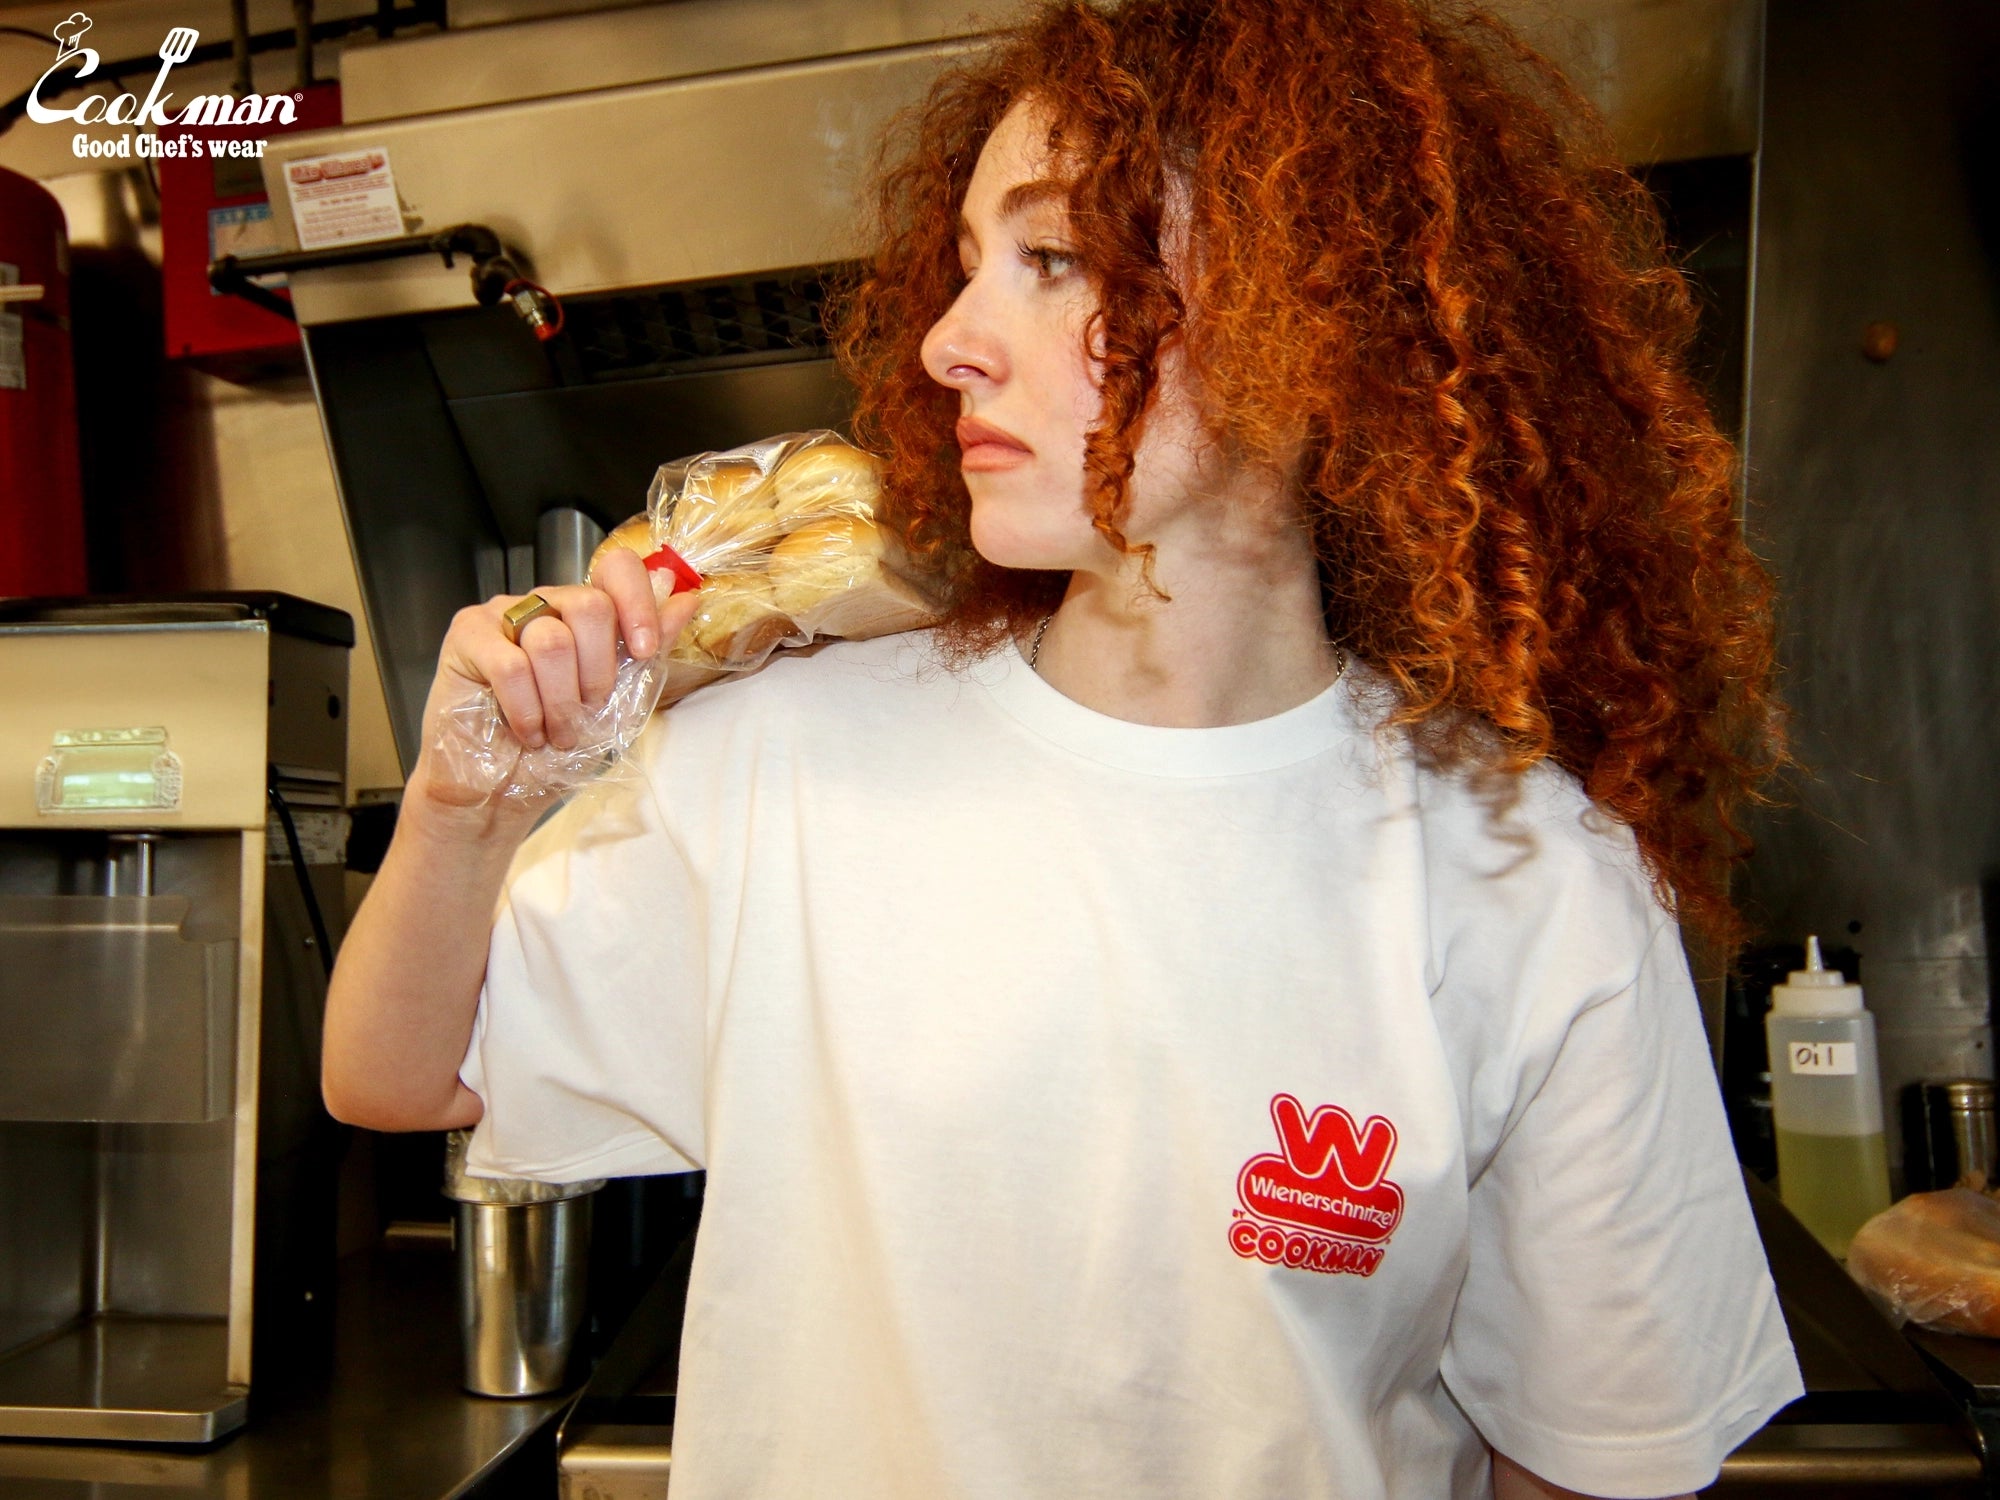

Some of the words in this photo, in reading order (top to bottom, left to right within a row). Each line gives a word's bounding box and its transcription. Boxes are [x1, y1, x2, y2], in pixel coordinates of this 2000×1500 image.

[1796, 1043, 1833, 1066] Oil
[1271, 1094, 1397, 1192] W
[1251, 1174, 1396, 1228] Wienerschnitzel
[1229, 1220, 1384, 1277] COOKMAN
